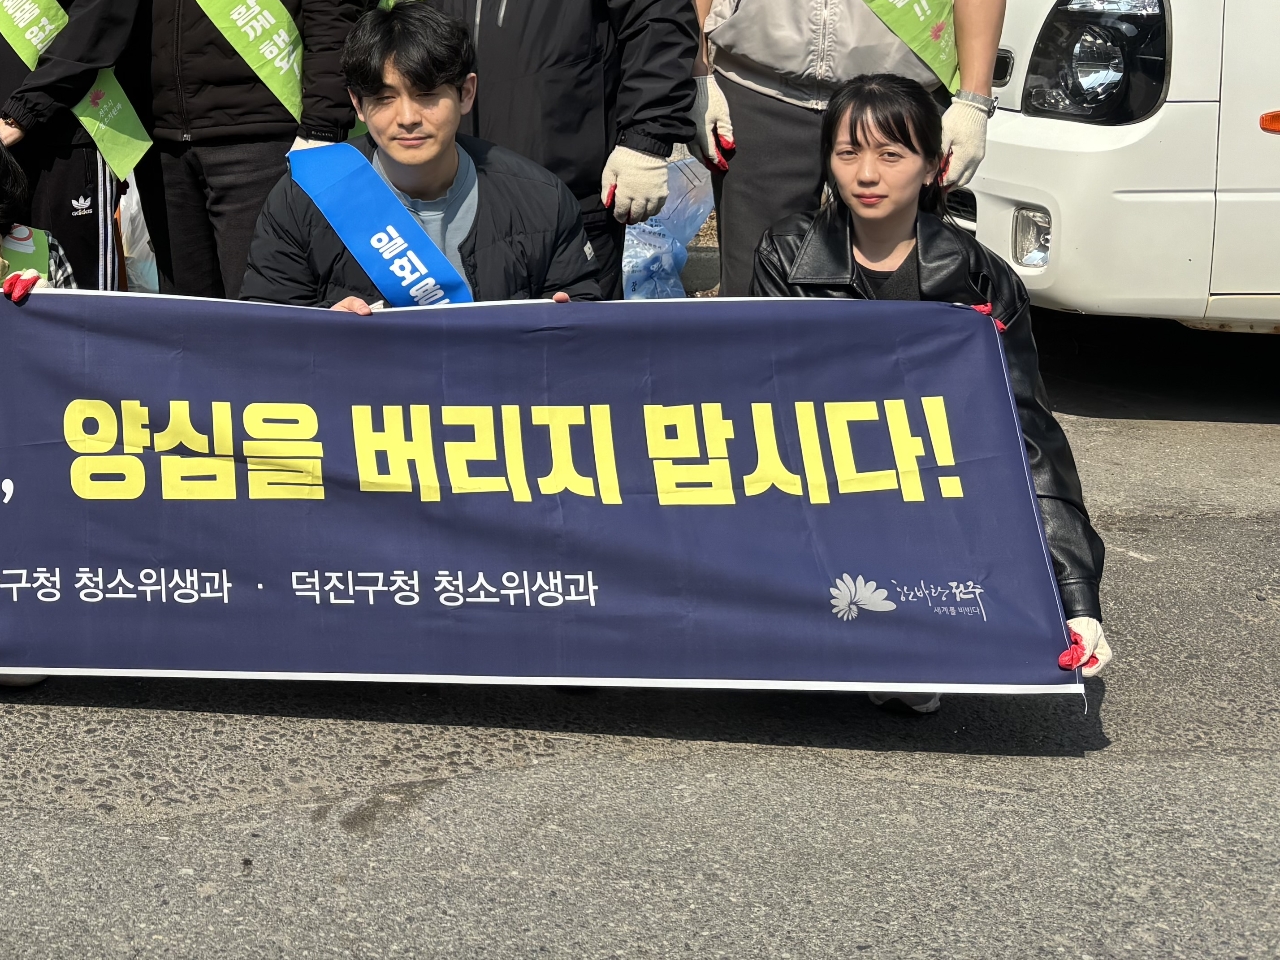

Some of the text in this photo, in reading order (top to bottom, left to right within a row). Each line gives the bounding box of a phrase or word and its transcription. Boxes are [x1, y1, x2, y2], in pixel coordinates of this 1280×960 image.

[72, 209, 93, 217] adidas
[370, 225, 450, 306] 일회용
[64, 398, 325, 501] 양심을
[352, 404, 623, 505] 버리지
[644, 396, 964, 506] 맙시다!
[75, 568, 232, 604] 청소위생과
[291, 570, 420, 606] 덕진구청
[433, 571, 598, 607] 청소위생과
[948, 581, 986, 622] 전주
